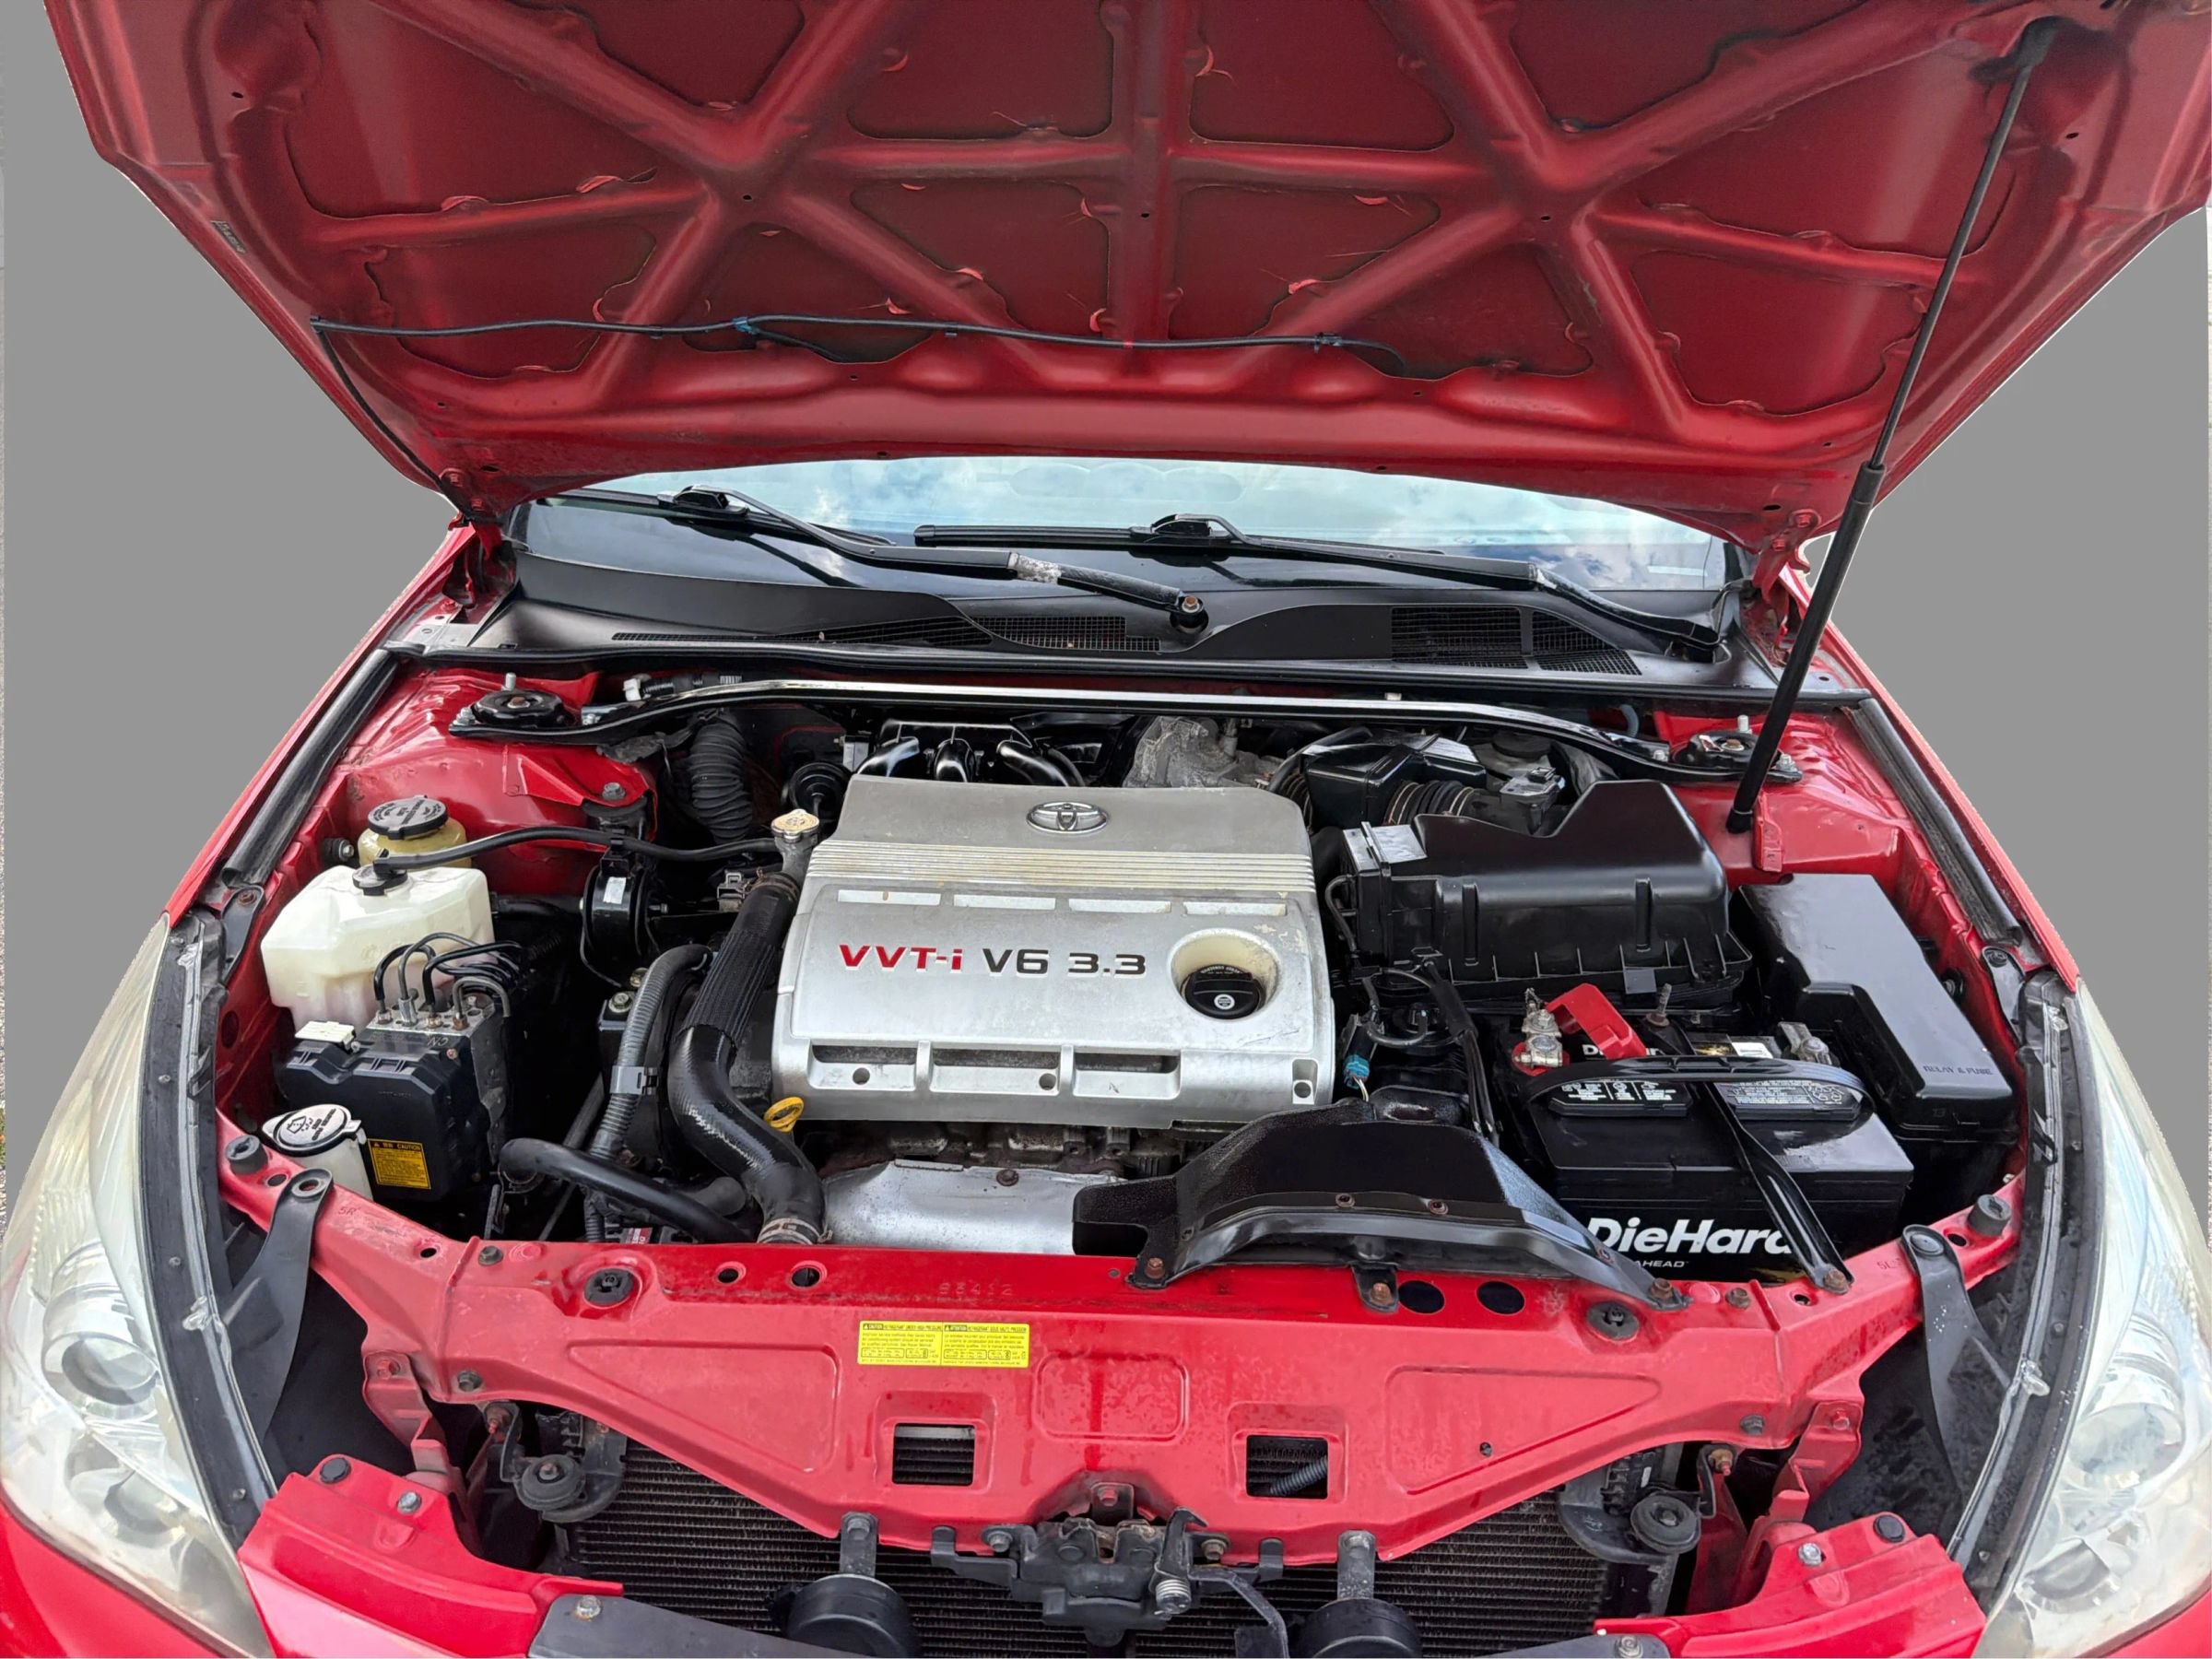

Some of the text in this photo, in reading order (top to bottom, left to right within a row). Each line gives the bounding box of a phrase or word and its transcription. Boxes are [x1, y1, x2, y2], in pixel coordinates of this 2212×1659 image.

[839, 944, 1147, 979] VVT-i V6 3.3
